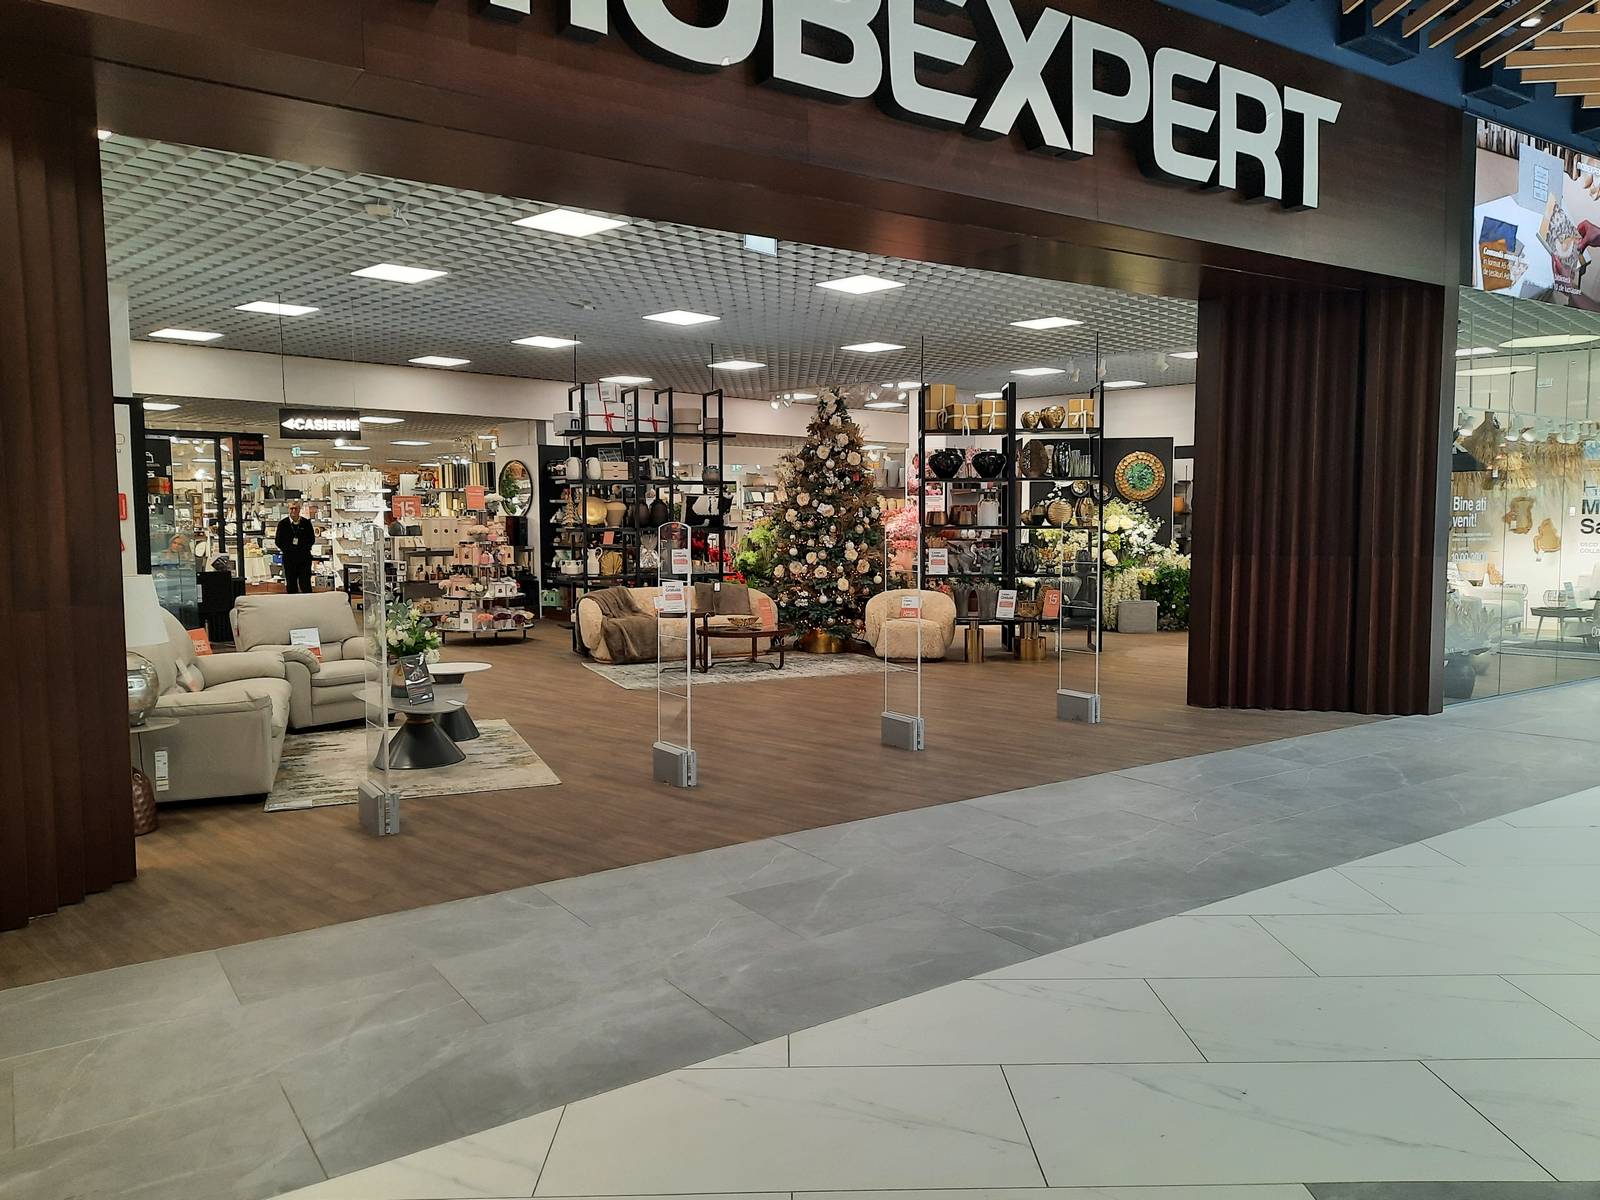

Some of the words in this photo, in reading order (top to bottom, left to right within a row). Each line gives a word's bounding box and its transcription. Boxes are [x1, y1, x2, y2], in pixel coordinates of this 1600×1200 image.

[489, 0, 1342, 209] BEXPERT
[400, 501, 416, 517] 15
[1453, 496, 1474, 511] Bine
[1452, 513, 1477, 528] venit!
